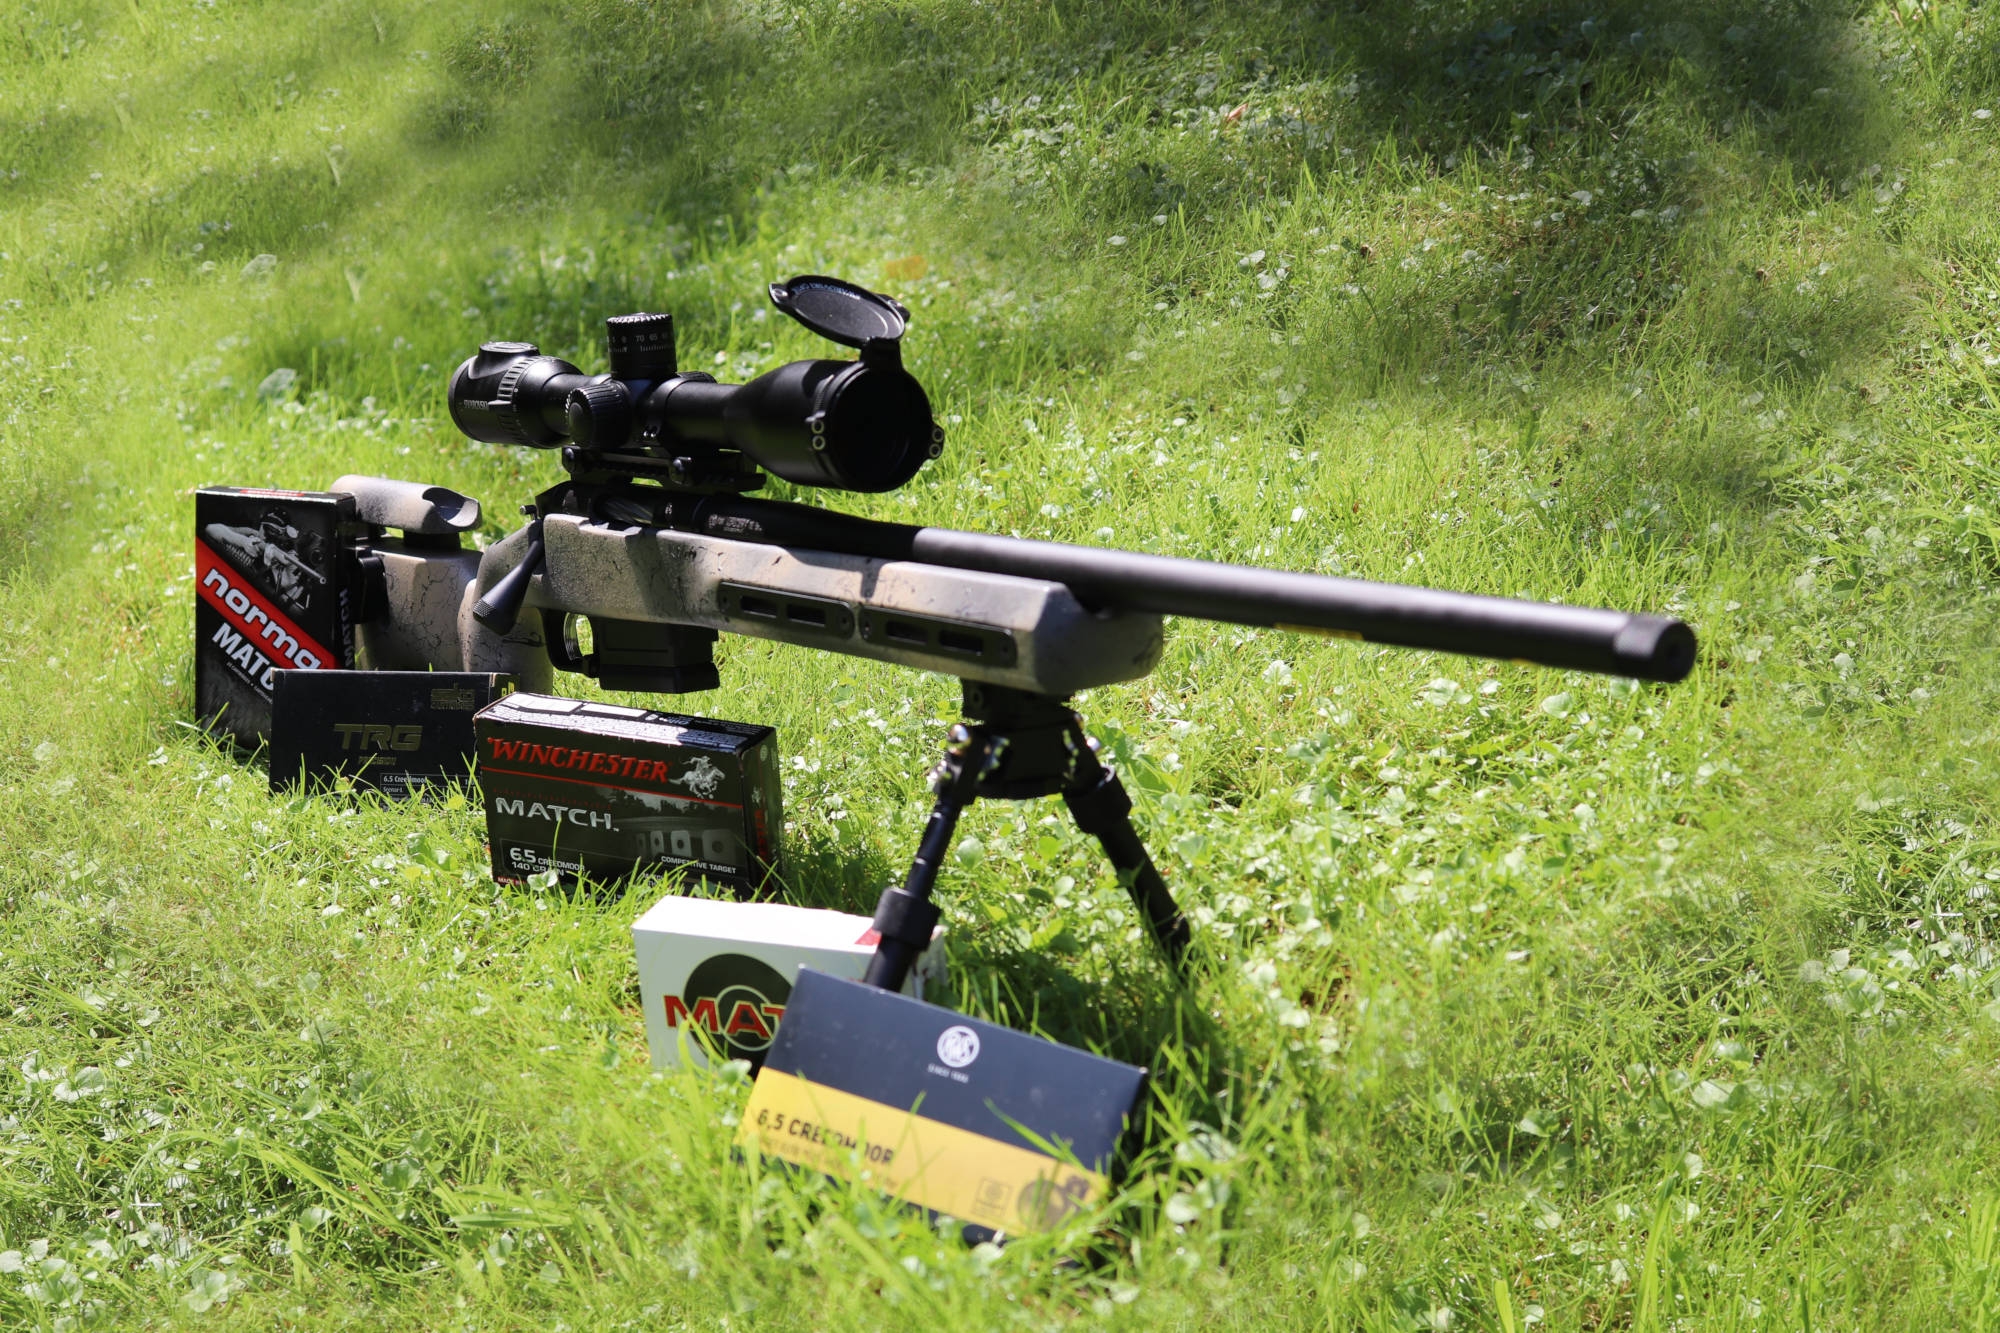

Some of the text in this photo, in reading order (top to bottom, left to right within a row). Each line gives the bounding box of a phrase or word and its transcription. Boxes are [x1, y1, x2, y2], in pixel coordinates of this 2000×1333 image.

[203, 568, 322, 670] norma
[212, 622, 275, 692] MATC
[334, 723, 423, 751] TRG
[487, 736, 669, 784] WINCHESTER
[383, 775, 394, 784] 6.5
[509, 847, 536, 864] 6.5
[511, 861, 565, 878] 140 GRN
[708, 863, 737, 875] TARGET
[663, 994, 786, 1040] MAT
